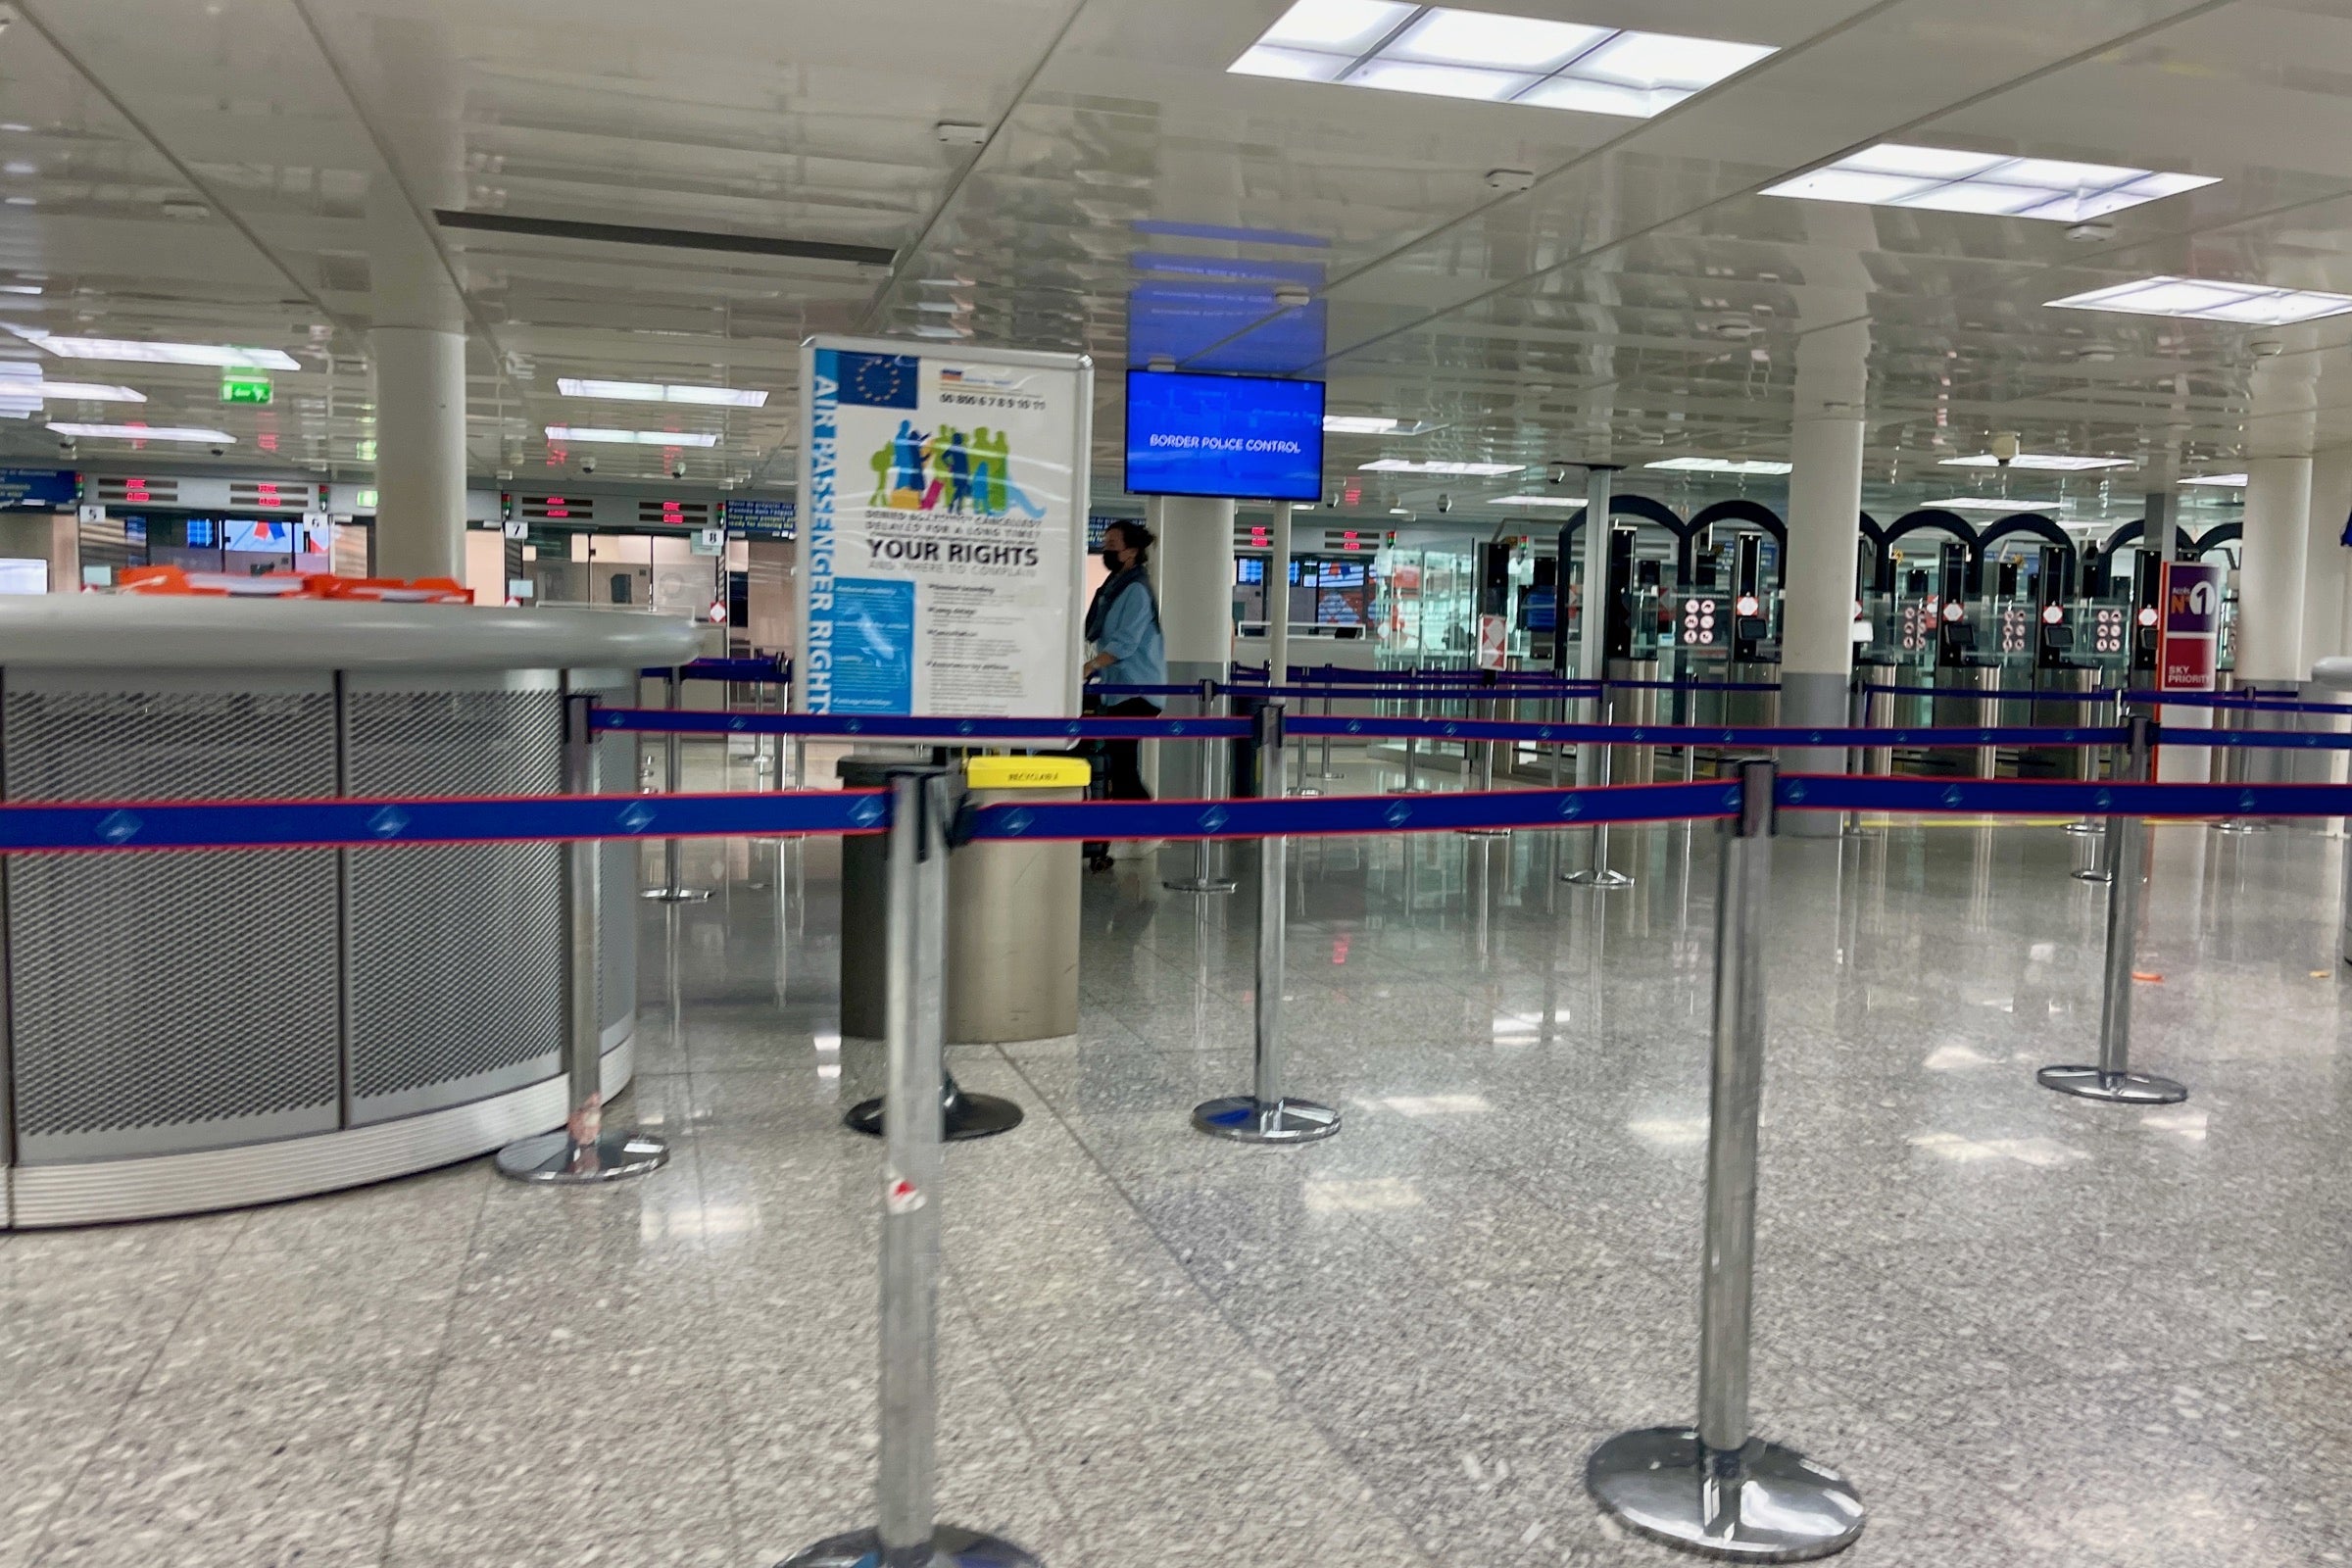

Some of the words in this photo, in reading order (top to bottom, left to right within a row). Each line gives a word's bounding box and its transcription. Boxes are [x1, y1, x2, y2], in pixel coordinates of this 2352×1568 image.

[812, 374, 839, 428] AIR
[1150, 434, 1200, 449] BORDER
[1201, 436, 1244, 452] POLICE
[1246, 439, 1301, 454] CONTROL
[866, 539, 941, 562] YOUR
[948, 544, 1040, 567] RIGHTS
[2169, 665, 2190, 675] SKY
